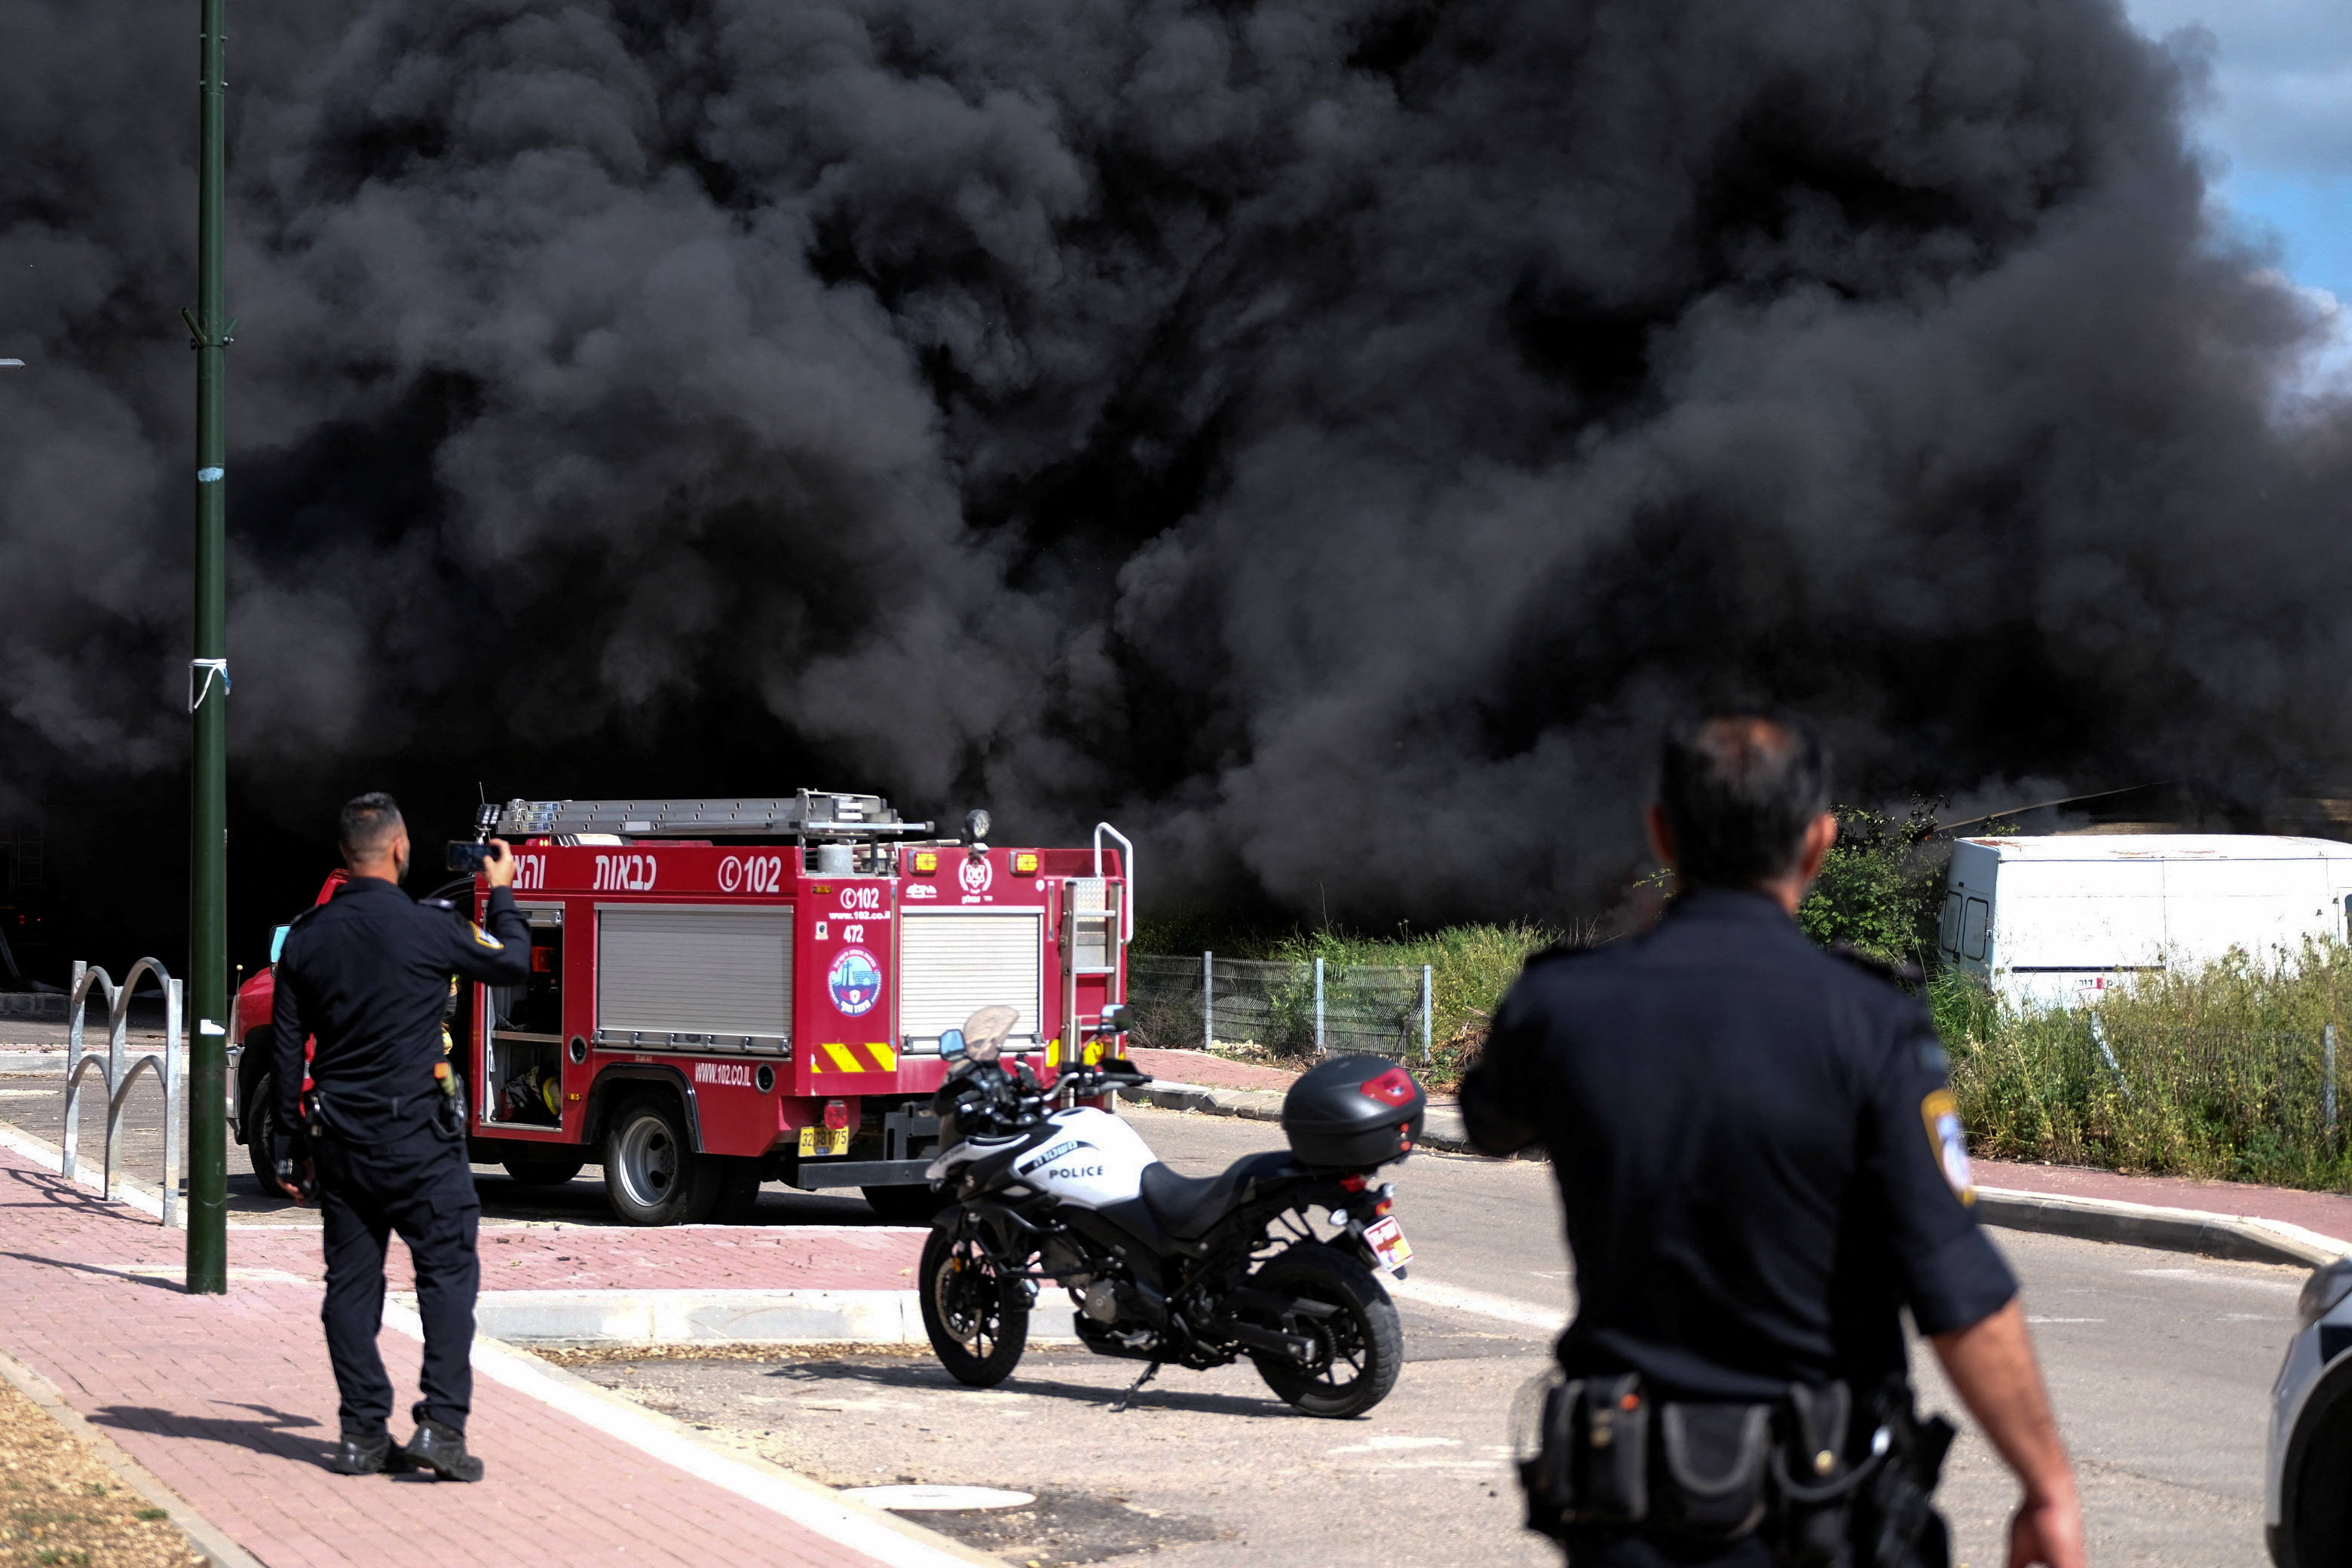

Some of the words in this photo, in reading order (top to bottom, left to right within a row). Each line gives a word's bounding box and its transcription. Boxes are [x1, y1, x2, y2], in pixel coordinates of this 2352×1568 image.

[488, 854, 546, 890] והצ
[593, 854, 657, 891] כבאות
[744, 856, 782, 893] 102
[856, 887, 880, 909] 102
[828, 911, 891, 920] www.102.co.il
[844, 924, 864, 943] 472
[695, 1062, 752, 1086] WWW.102.CO.IL
[1034, 1141, 1078, 1168] משטרה
[1049, 1165, 1104, 1179] POLICE
